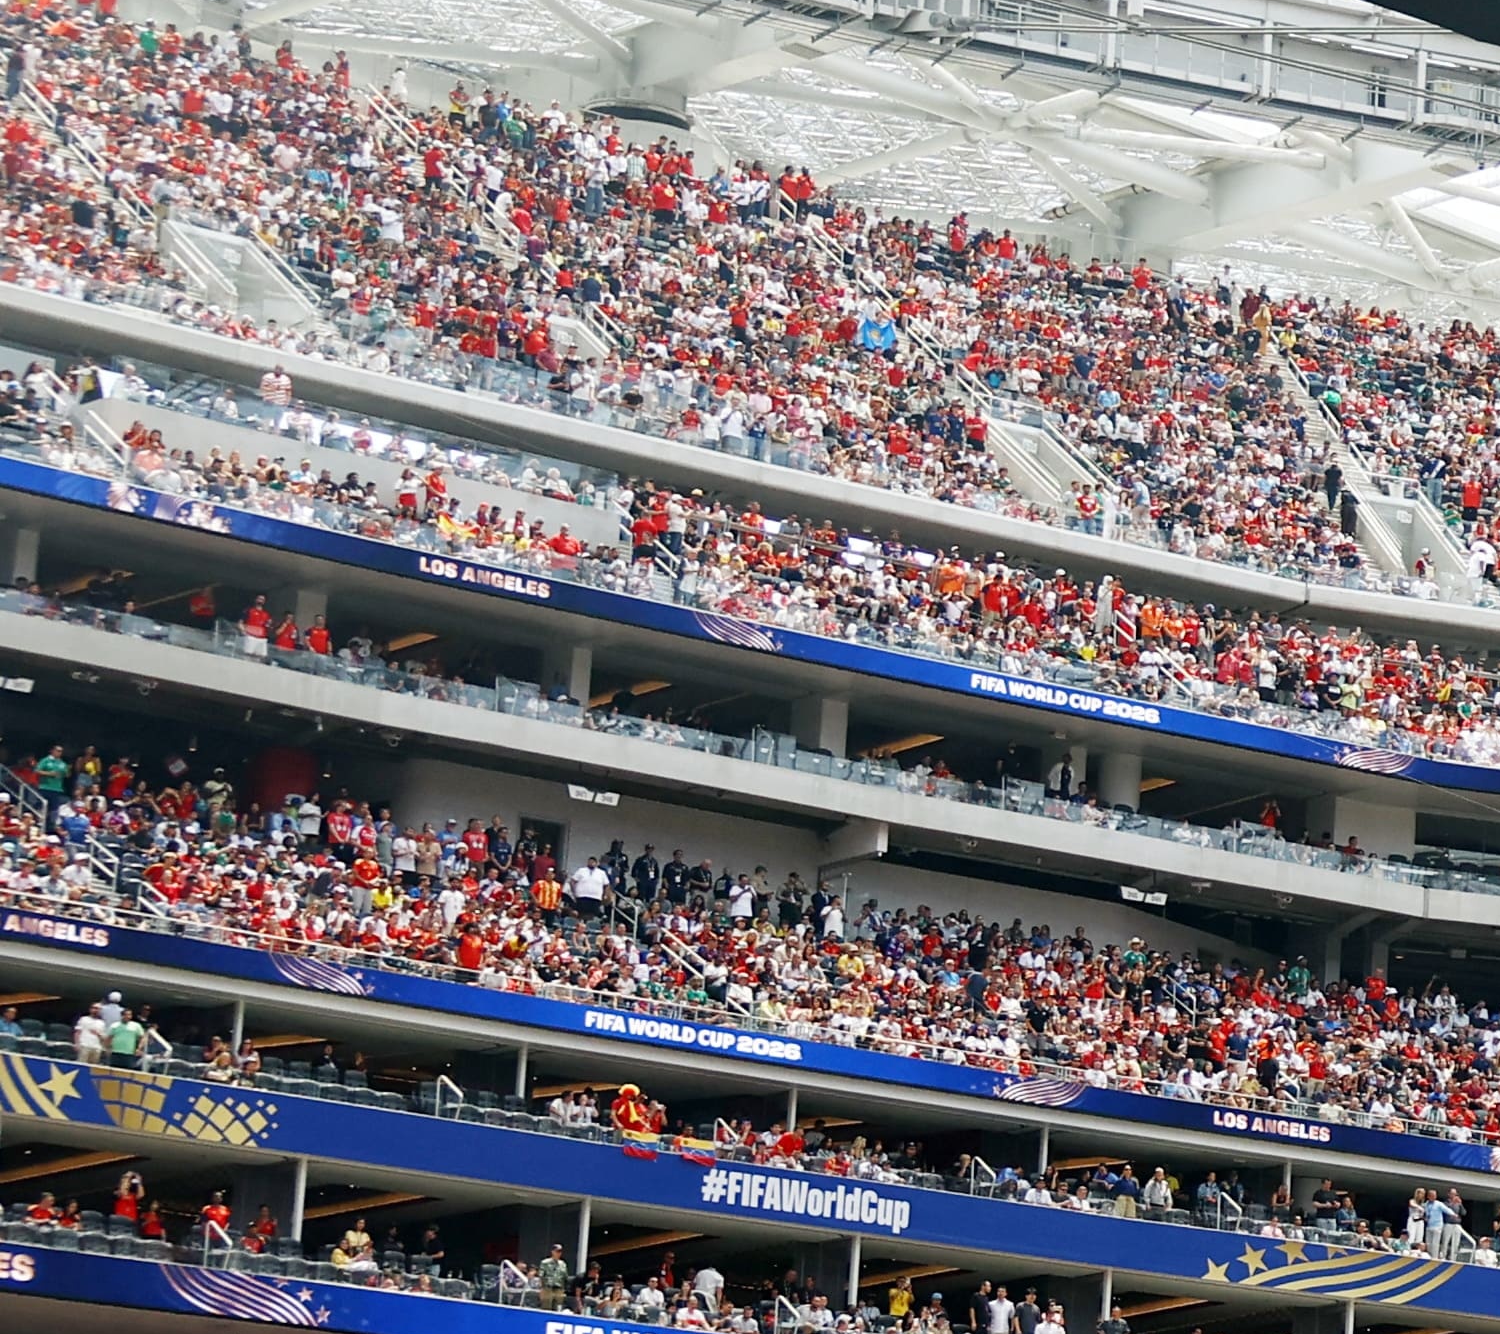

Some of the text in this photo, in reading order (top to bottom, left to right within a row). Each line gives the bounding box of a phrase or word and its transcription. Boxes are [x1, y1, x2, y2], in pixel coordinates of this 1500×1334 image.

[419, 556, 550, 598] LOS ANGELES
[971, 674, 1160, 724] FIFA WORLD CUP 2026
[4, 914, 109, 946] ANGELES
[585, 1011, 803, 1060] FIFA WORLD CUP 2026
[1213, 1111, 1331, 1142] LOS ANGELES
[702, 1169, 909, 1233] #FIFAWorldCup
